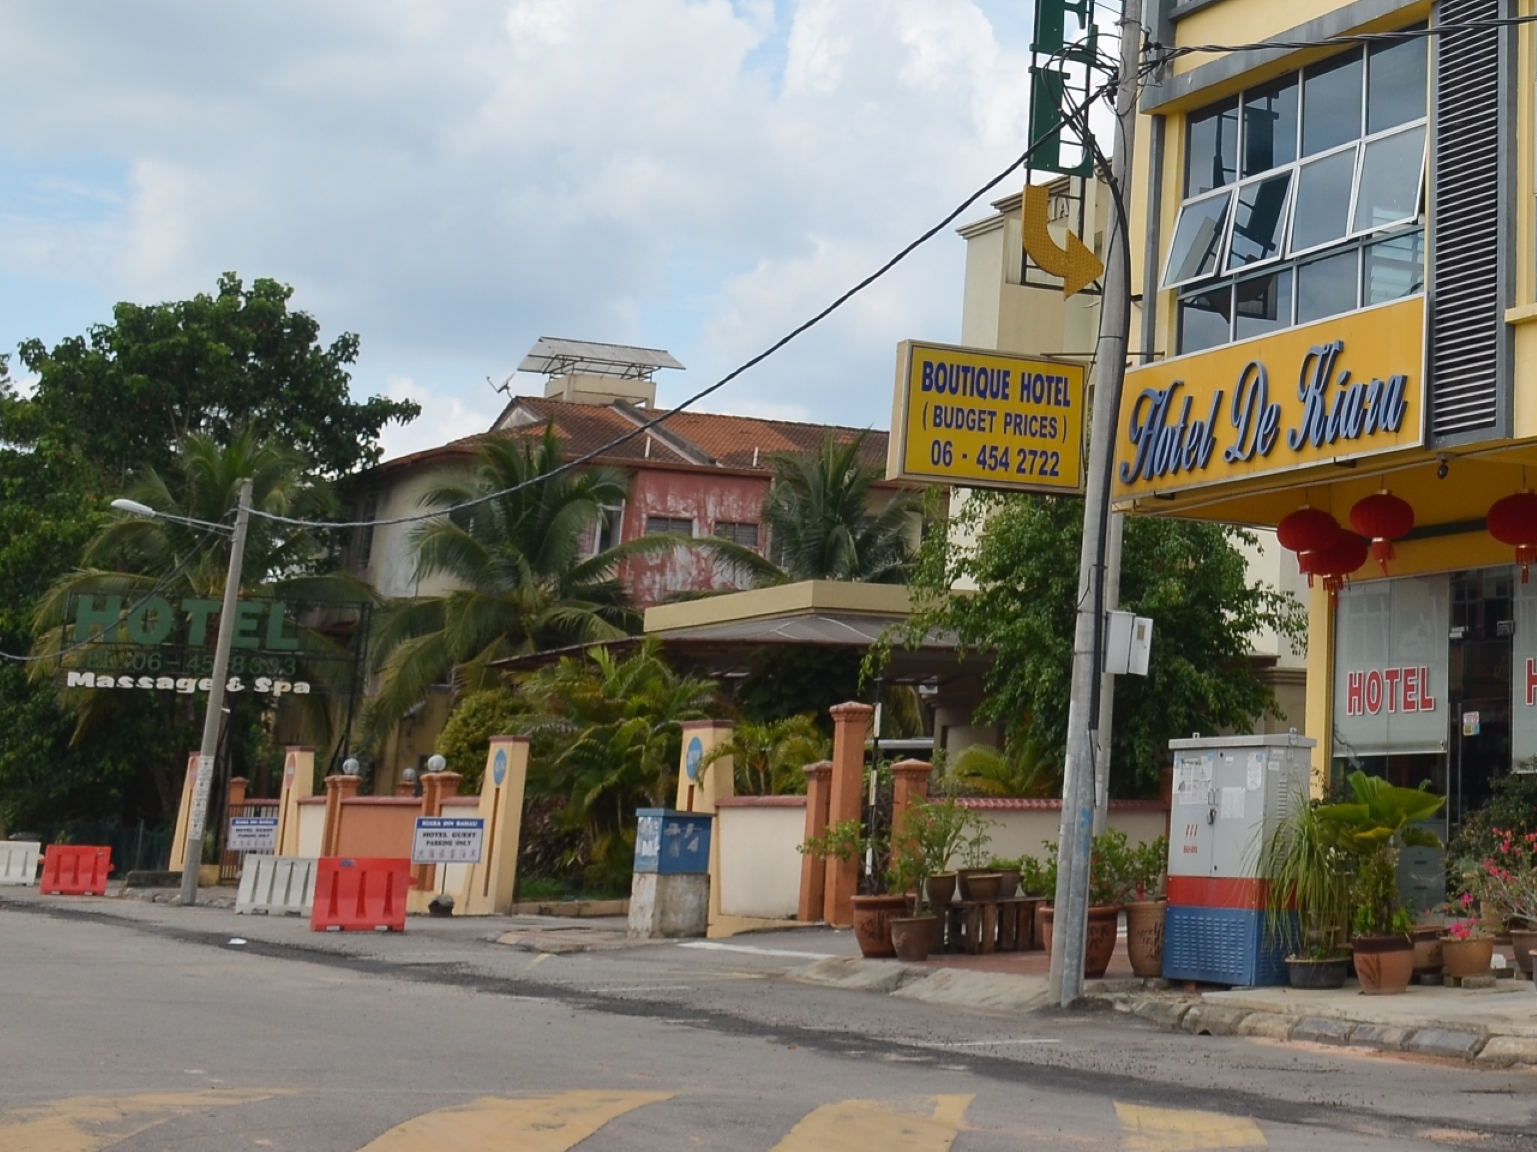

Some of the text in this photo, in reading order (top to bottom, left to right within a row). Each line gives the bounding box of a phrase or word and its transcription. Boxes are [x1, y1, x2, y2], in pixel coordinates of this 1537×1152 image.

[921, 360, 1070, 408] BOUTIQUE HOTEL
[1119, 339, 1408, 484] Hotel De Kiara
[931, 439, 953, 467] 06
[976, 444, 1010, 472] 454
[1016, 448, 1060, 477] 2722
[75, 594, 299, 649] HOTEL
[68, 671, 214, 694] Massage
[254, 676, 310, 697] Spa
[1346, 666, 1434, 715] HOTEL
